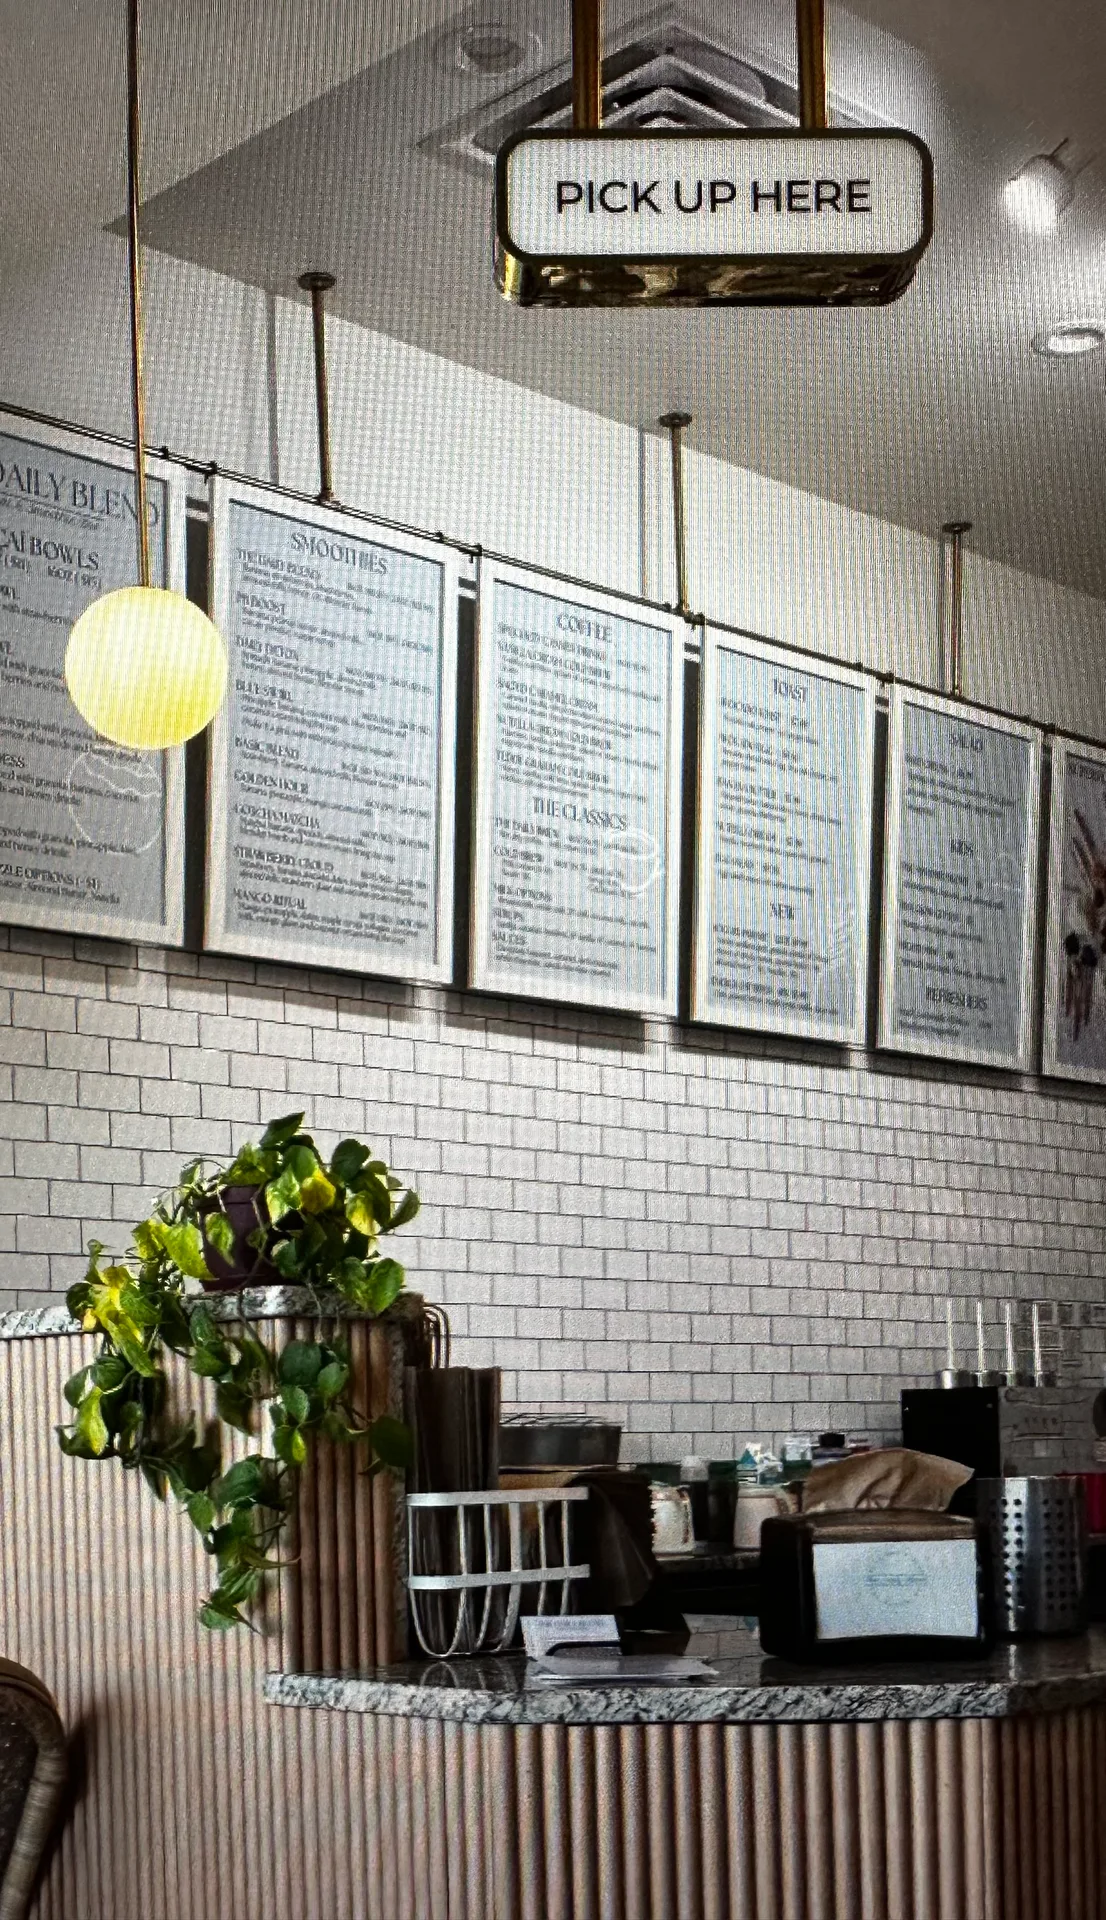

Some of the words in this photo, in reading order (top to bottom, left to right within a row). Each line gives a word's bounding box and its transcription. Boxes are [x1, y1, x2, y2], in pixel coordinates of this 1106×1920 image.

[557, 180, 662, 214] PICK
[675, 180, 737, 214] UP
[752, 179, 872, 213] HERE
[72, 480, 160, 528] BLEND
[30, 536, 99, 570] BOWLS
[290, 532, 388, 576] SMOOTHIES
[556, 612, 613, 643] COFFEE
[533, 796, 560, 818] THE
[561, 803, 629, 832] CLASSICS
